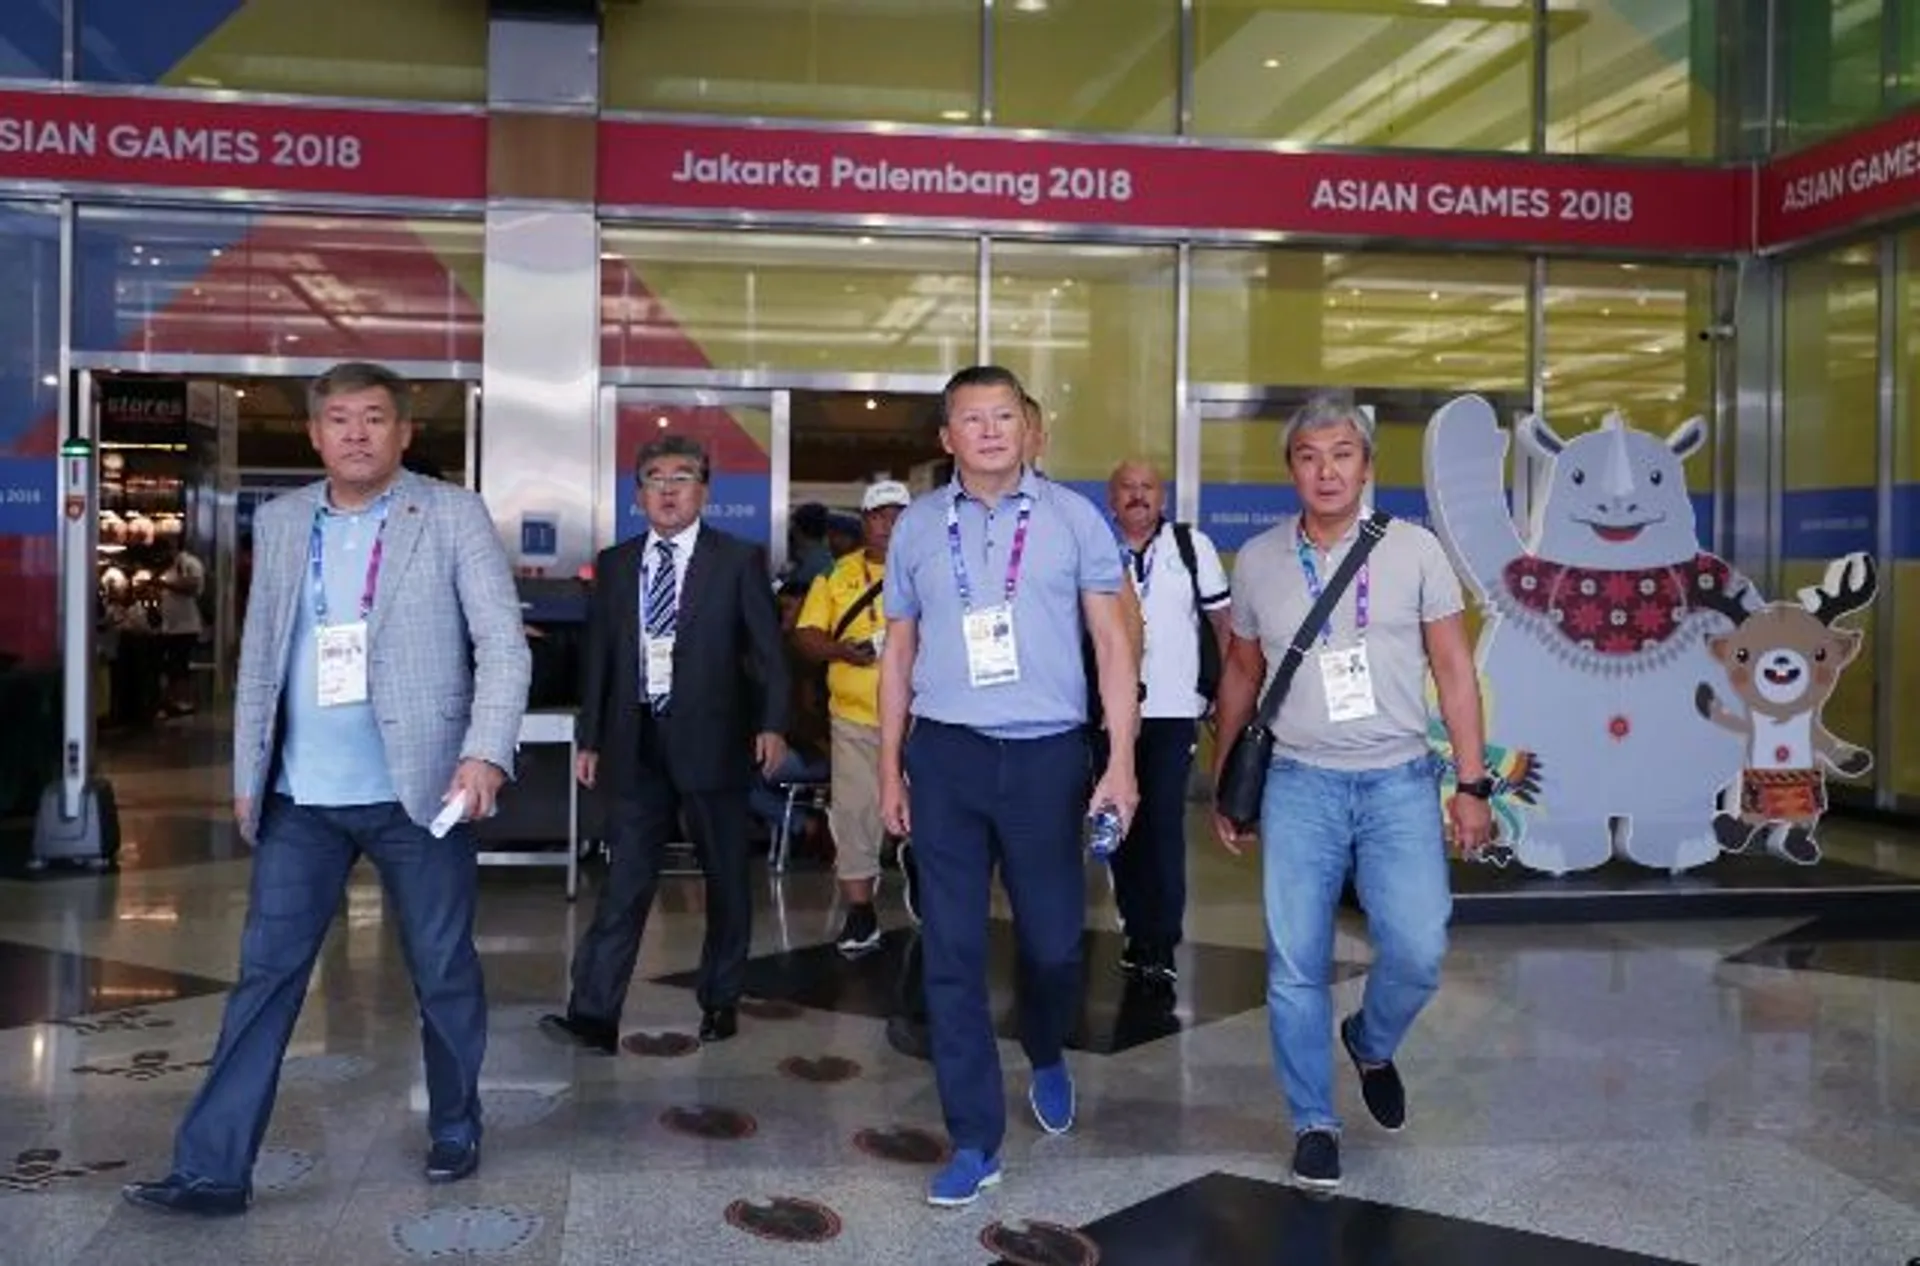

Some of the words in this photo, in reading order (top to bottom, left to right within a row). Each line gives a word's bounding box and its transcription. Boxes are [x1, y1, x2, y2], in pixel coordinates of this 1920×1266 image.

[108, 125, 260, 164] GAMES
[271, 132, 362, 169] 2018
[672, 151, 820, 188] Jakarta
[831, 157, 1040, 205] Palembang
[1048, 168, 1132, 201] 2018
[1311, 179, 1417, 213] ASIAN
[1427, 184, 1550, 218] GAMES
[1559, 189, 1634, 222] 2018
[1781, 164, 1845, 214] ASIAN
[1848, 140, 1920, 193] GAME
